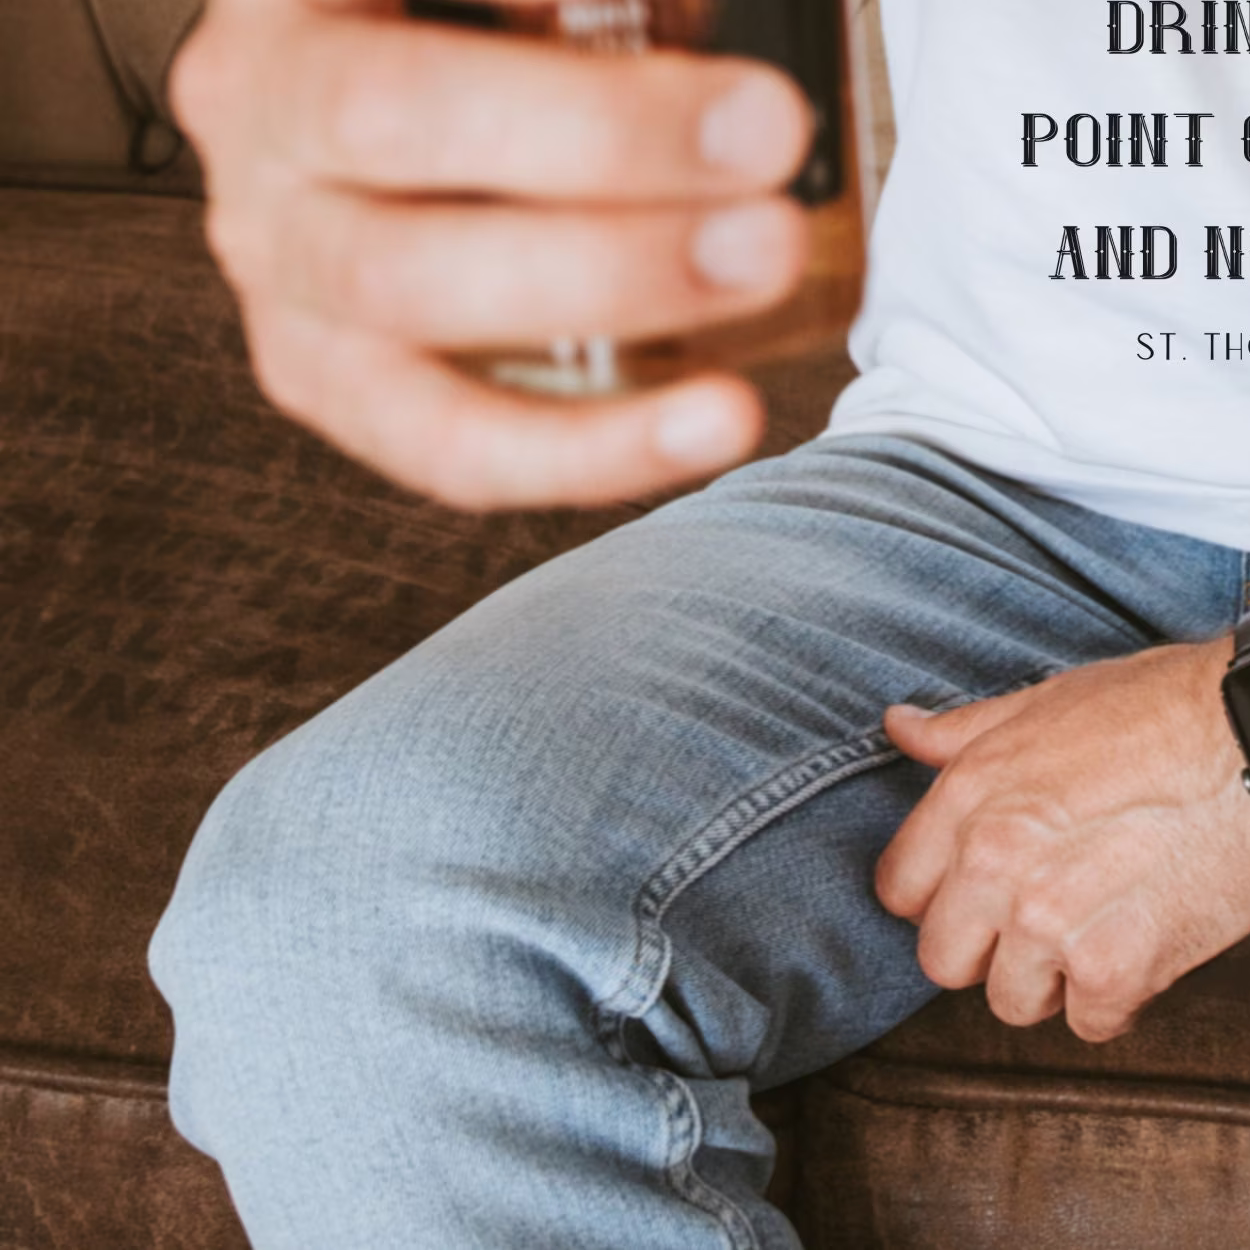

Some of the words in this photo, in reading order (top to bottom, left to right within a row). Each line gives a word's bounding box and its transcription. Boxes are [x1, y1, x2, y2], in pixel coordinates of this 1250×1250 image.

[1021, 113, 1214, 167] POINT
[1048, 226, 1177, 279] AND
[1137, 333, 1186, 360] ST.
